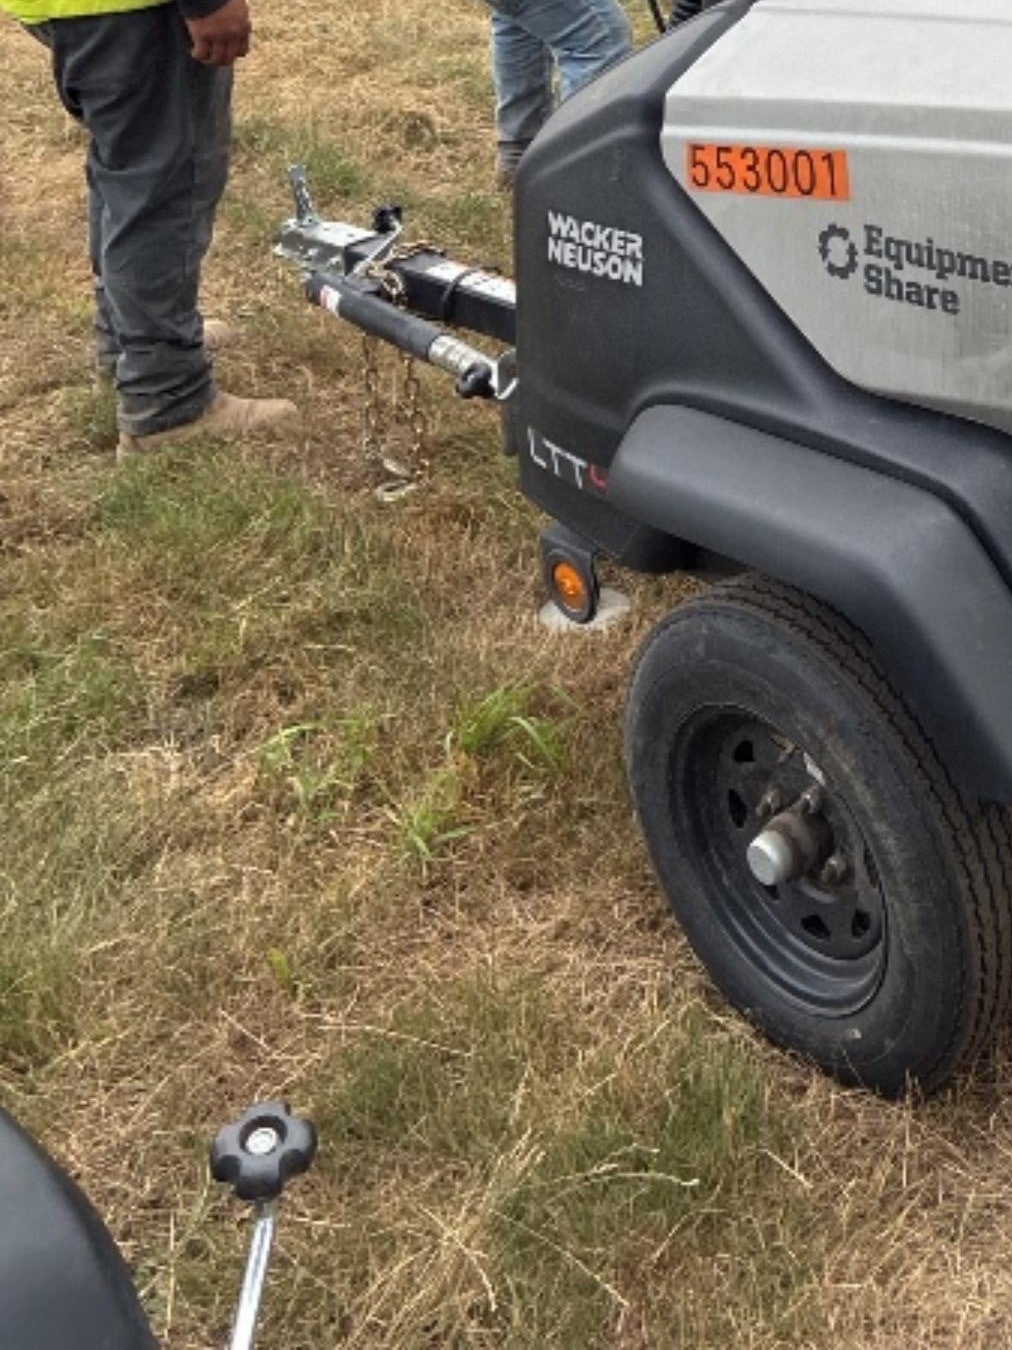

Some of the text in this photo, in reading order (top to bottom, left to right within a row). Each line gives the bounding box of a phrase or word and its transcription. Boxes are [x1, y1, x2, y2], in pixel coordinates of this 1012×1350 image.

[688, 143, 839, 196] 553001
[547, 209, 644, 259] WACKER
[547, 236, 644, 287] NEUSON
[863, 263, 961, 316] Share
